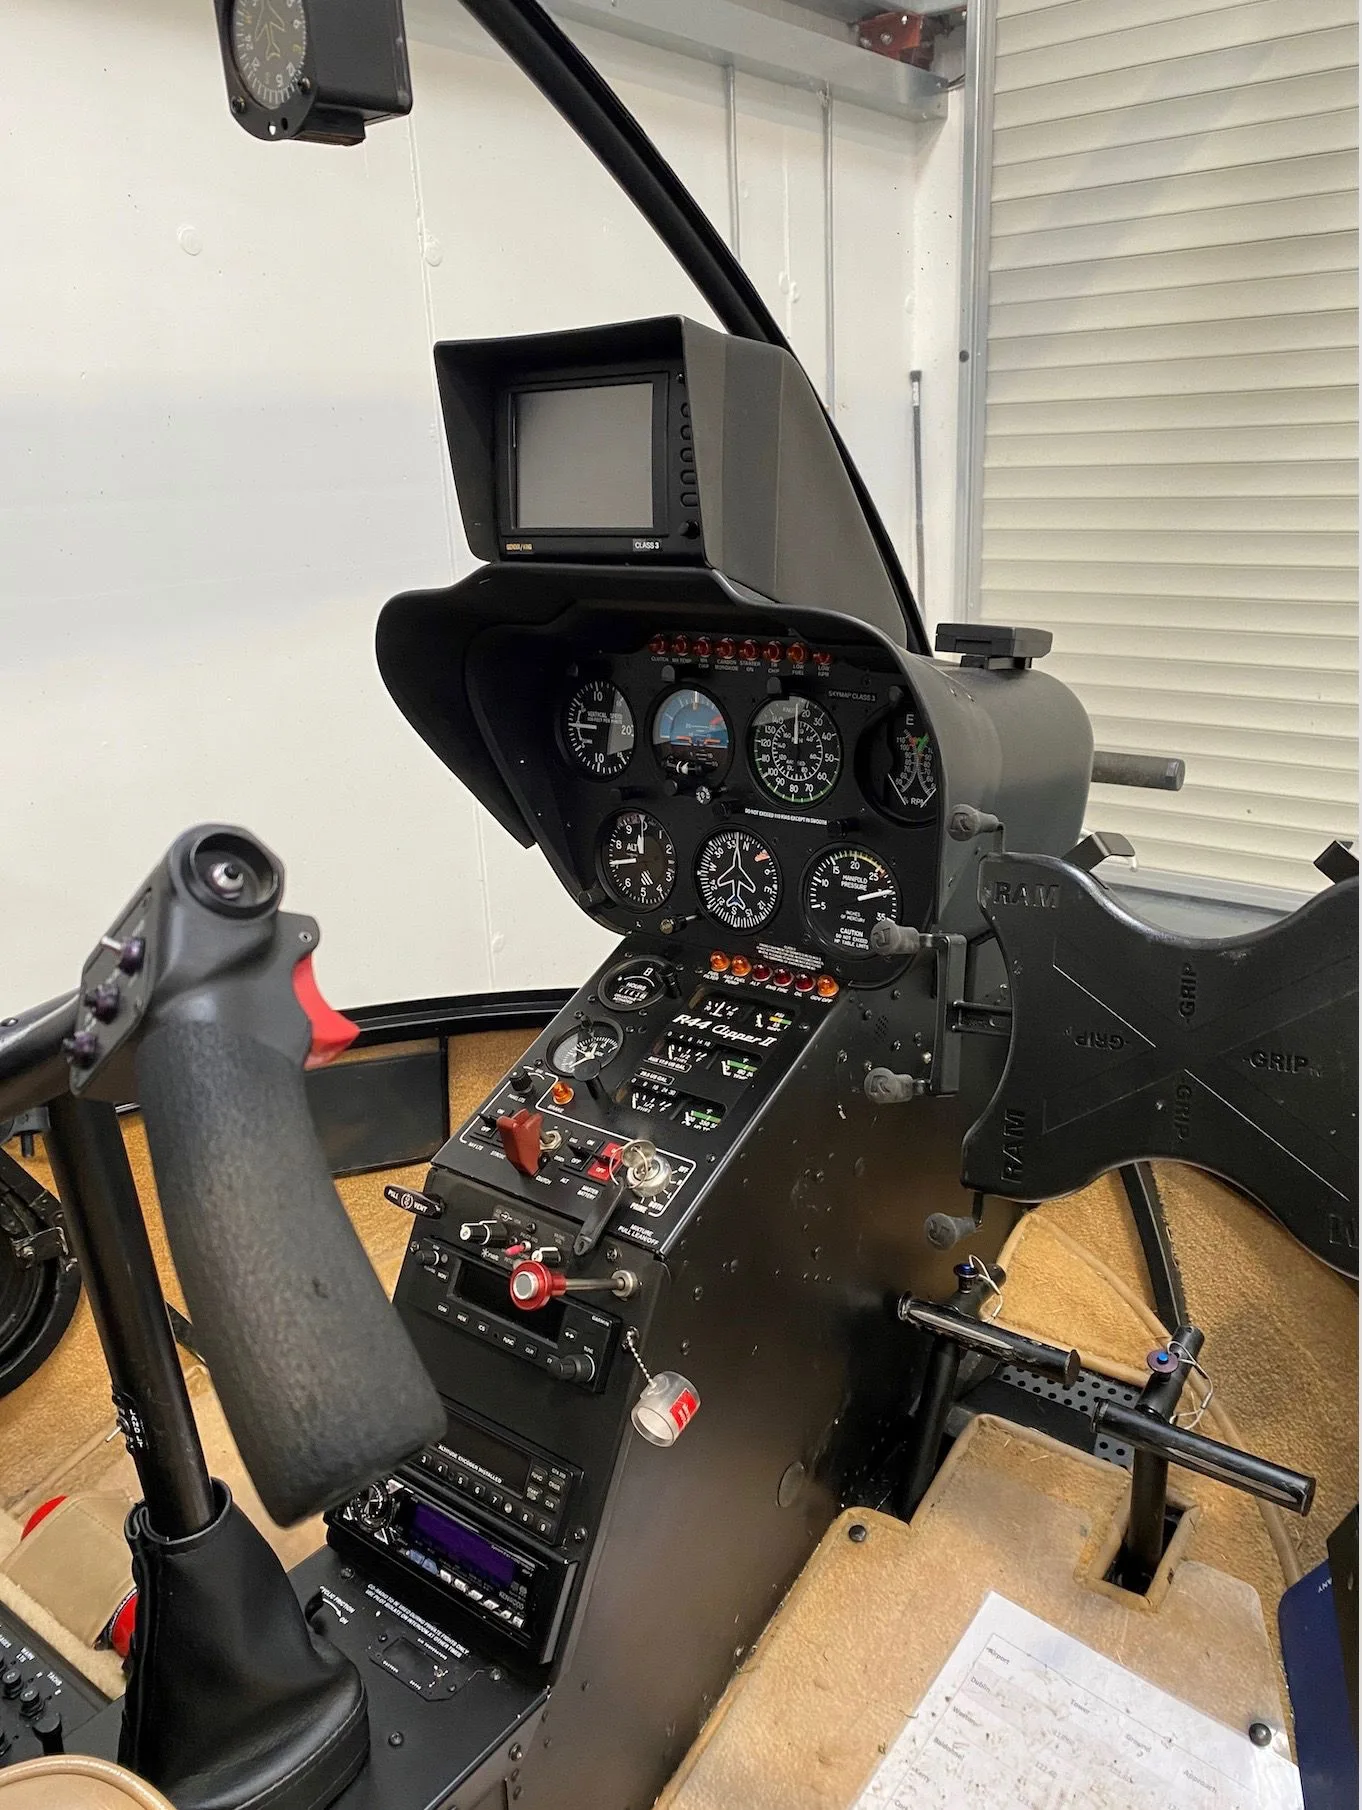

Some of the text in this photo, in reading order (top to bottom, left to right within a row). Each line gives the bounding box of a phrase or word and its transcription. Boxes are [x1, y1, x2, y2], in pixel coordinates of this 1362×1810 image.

[634, 541, 660, 550] CLASS 3
[594, 691, 602, 701] 10
[802, 710, 810, 718] 20
[813, 718, 823, 726] 30
[906, 714, 914, 726] E
[621, 725, 631, 735] 20
[822, 732, 832, 740] 40
[595, 752, 604, 763] 10
[824, 753, 834, 762] 50
[767, 768, 778, 776] 100
[817, 772, 827, 780] 60
[775, 777, 785, 786] 90
[790, 784, 798, 793] 80
[805, 783, 814, 792] 70
[625, 825, 632, 834] 9
[659, 830, 662, 839] 1
[615, 840, 622, 850] 8
[665, 844, 672, 855] 2
[726, 840, 736, 849] 33
[742, 842, 750, 851] N
[714, 847, 724, 859] 30
[709, 862, 717, 872] W
[833, 865, 840, 874] 15
[850, 861, 860, 870] 20
[665, 872, 672, 882] 3
[842, 874, 868, 884] MANIFOLD
[868, 872, 879, 881] 25
[624, 877, 631, 887] 6
[709, 879, 718, 891] 24
[821, 879, 829, 887] 10
[841, 880, 867, 891] PRESSURE
[640, 887, 647, 897] 5
[656, 884, 663, 893] 4
[764, 886, 773, 895] E
[994, 882, 1060, 908] RAM
[757, 900, 766, 910] 12
[820, 902, 826, 910] 5
[731, 906, 737, 915] S
[876, 912, 886, 921] 35
[840, 928, 864, 937] CAUTION
[856, 942, 869, 950] LIMITS
[1179, 964, 1196, 1018] GRIP
[673, 1014, 712, 1030] R44
[712, 1024, 762, 1043] Clipper
[1249, 1049, 1311, 1074] GRIP
[1176, 1084, 1193, 1140] GRIP
[1000, 1108, 1024, 1184] RAM
[577, 1189, 596, 1200] BATTERY
[581, 1184, 599, 1196] MASTER
[388, 1189, 428, 1213] PULL VENT
[648, 1201, 664, 1211] BOTH
[618, 1225, 632, 1235] PULL
[630, 1224, 654, 1237] MIXTURE
[502, 1336, 515, 1346] FUNC
[583, 1345, 594, 1354] TUNE
[130, 1409, 141, 1433] LAND
[136, 1435, 143, 1448] LT
[438, 1444, 502, 1484] ALTITUDE ENCODER INSTALLED
[523, 1513, 528, 1522] 8
[334, 1596, 356, 1614] FRICTION
[498, 1590, 524, 1610] KENWOOD
[339, 1616, 349, 1624] ON
[365, 1589, 375, 1597] USE
[373, 1594, 386, 1604] PILOT
[384, 1602, 402, 1616] ISOLATE
[407, 1618, 430, 1635] INTERCOM
[433, 1636, 449, 1649] OTHER
[398, 1604, 412, 1615] USED
[409, 1611, 426, 1625] DURING
[424, 1622, 443, 1636] PRIVATE
[988, 1648, 1010, 1665] Airport
[970, 1676, 991, 1693] Dublin
[1070, 1698, 1090, 1714] Tower
[1184, 1770, 1218, 1794] Approach
